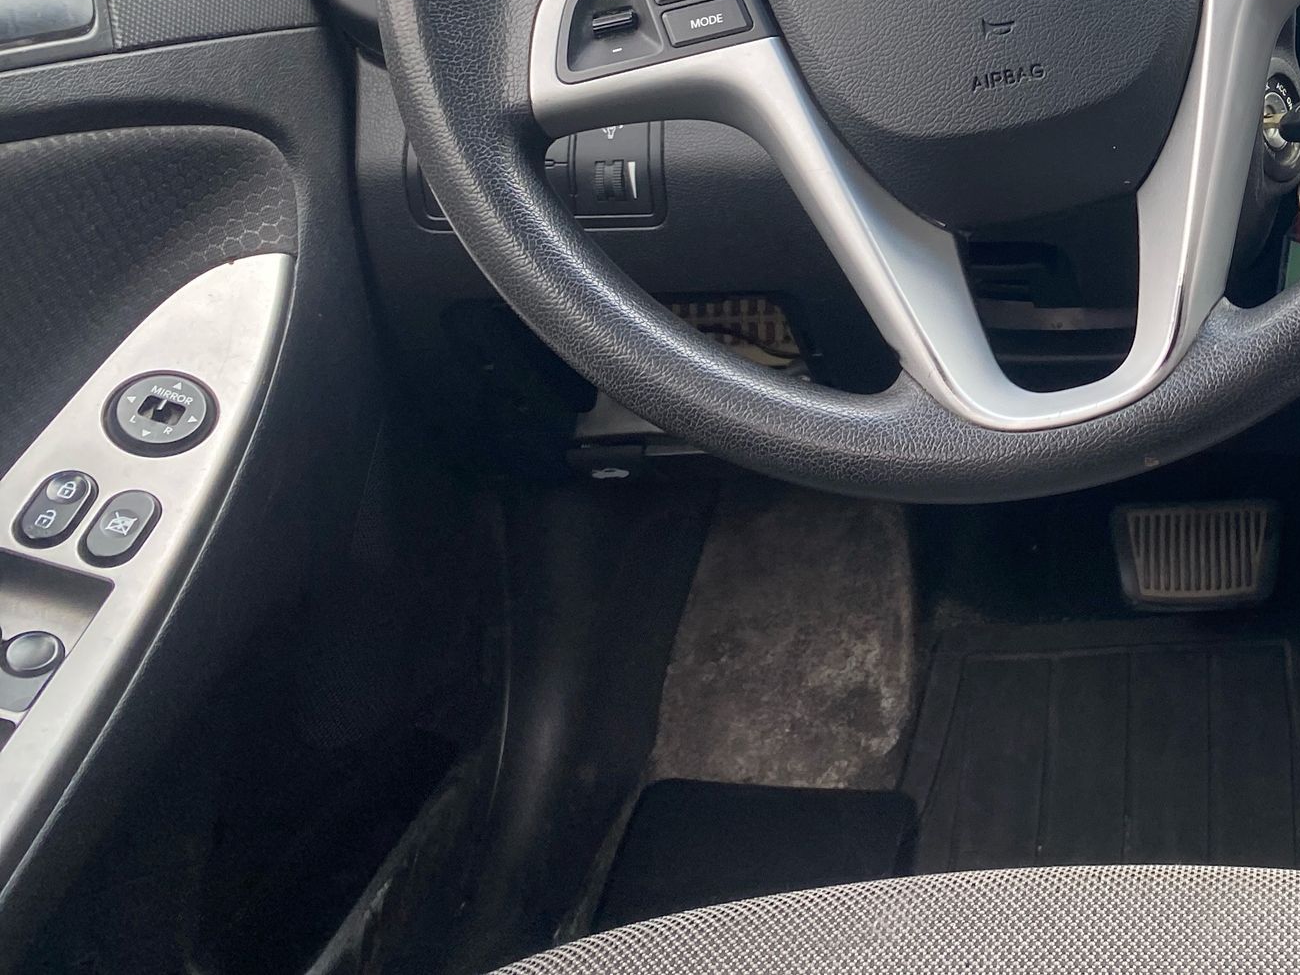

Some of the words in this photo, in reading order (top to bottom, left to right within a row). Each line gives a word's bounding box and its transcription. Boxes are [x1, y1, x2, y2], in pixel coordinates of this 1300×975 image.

[690, 13, 724, 29] MODE
[971, 64, 1046, 92] AIRBAG
[151, 385, 193, 405] MIRROR
[129, 415, 136, 423] L
[163, 426, 173, 435] R
